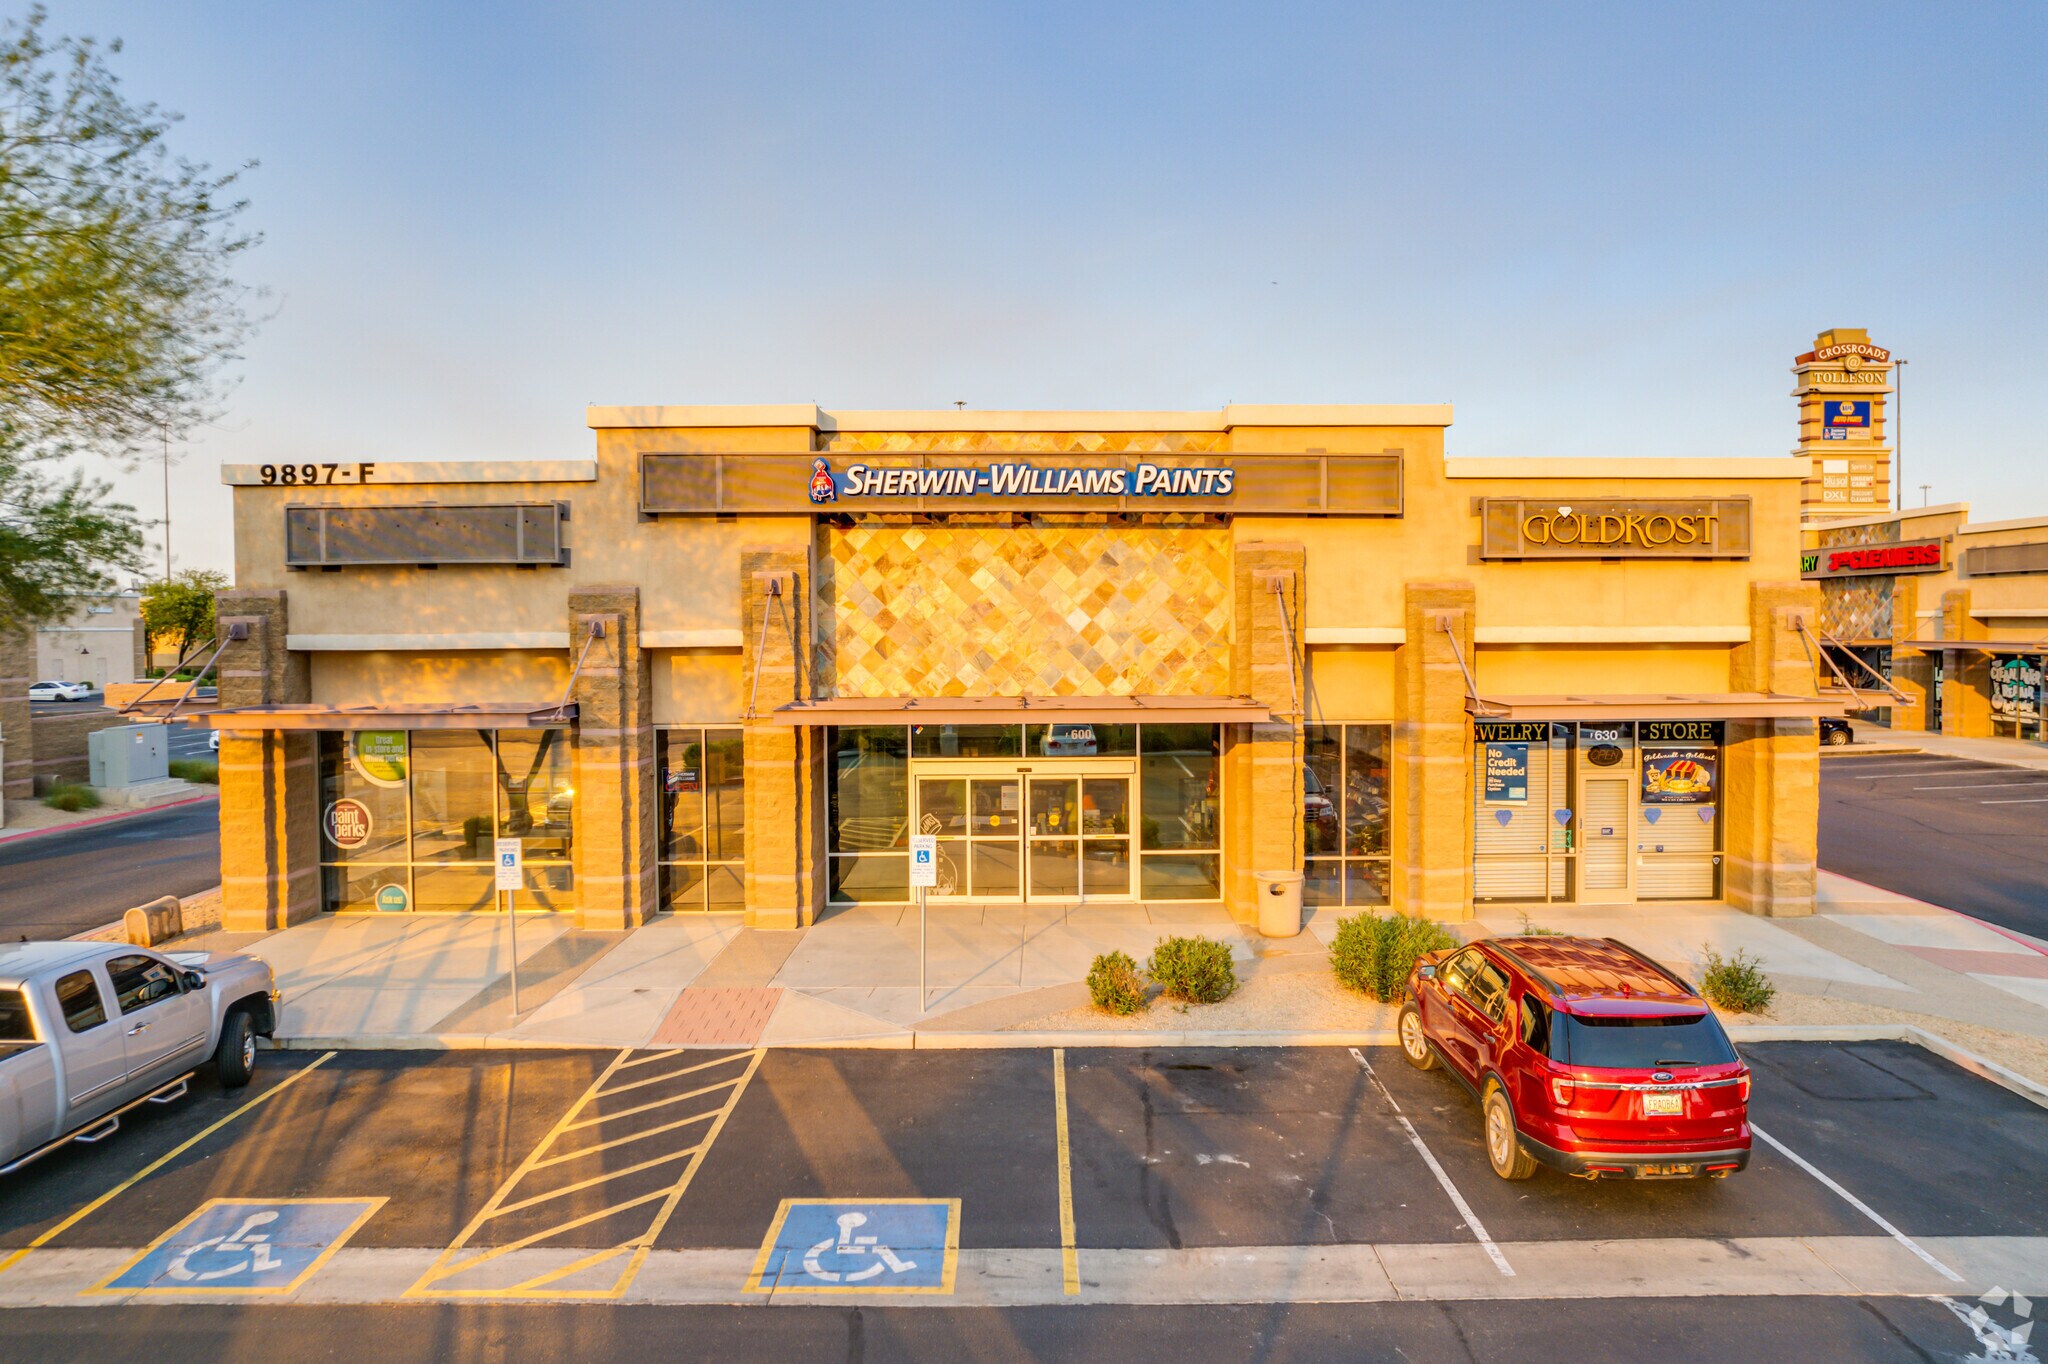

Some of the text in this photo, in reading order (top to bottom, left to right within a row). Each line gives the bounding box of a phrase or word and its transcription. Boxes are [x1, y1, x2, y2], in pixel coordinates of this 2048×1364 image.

[1818, 344, 1887, 360] CROSSROADS
[1847, 355, 1861, 370] @
[1814, 372, 1883, 383] TOLLESON
[1134, 464, 1234, 494] PAINTS
[1824, 491, 1847, 499] DXL
[1522, 514, 1719, 548] GOLDKOST
[1849, 545, 1940, 570] CLEANERS
[1071, 729, 1091, 740] 600
[1650, 723, 1711, 739] STORE
[1488, 749, 1502, 758] No
[1488, 758, 1517, 766] Credit
[1488, 767, 1525, 776] Needed
[665, 782, 698, 791] OPEN
[331, 808, 359, 826] paint
[335, 822, 365, 839] perks
